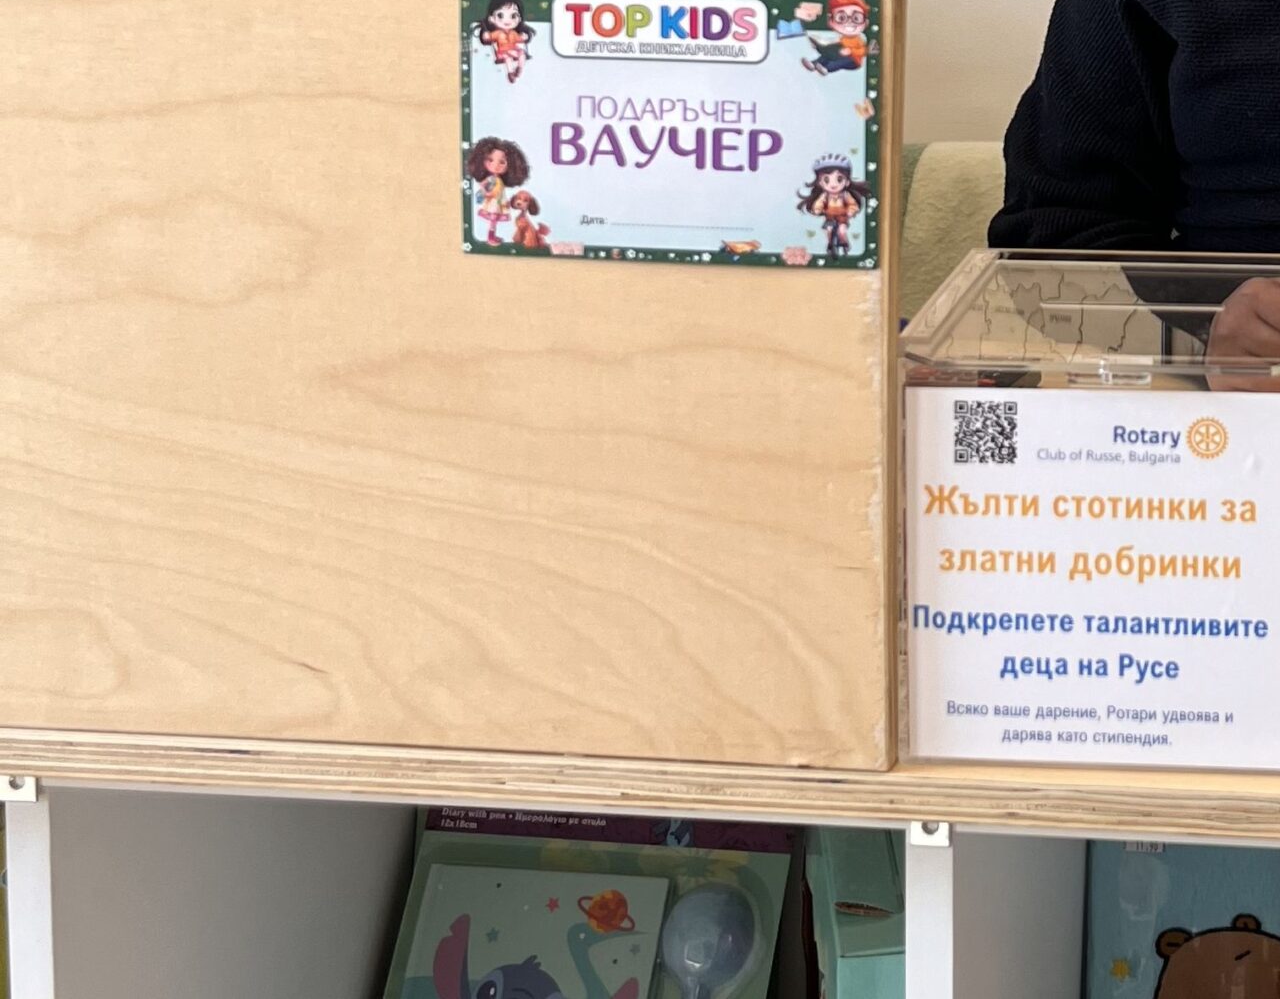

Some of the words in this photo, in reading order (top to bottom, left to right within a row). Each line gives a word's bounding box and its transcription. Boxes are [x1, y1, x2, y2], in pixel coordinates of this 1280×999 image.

[564, 2, 653, 38] TOP
[660, 4, 758, 42] KIDS
[575, 40, 636, 56] ДЕТСКА
[639, 42, 748, 58] КНИЖАРНИЦА
[576, 95, 757, 124] ПОДАРЪЧЕН
[550, 121, 784, 172] ВАУЧЕР
[579, 214, 609, 226] Дата:
[1113, 425, 1182, 448] Rotary
[1037, 448, 1066, 462] Club
[1069, 448, 1083, 462] of
[1086, 449, 1125, 464] Russe,
[1129, 450, 1182, 466] Bulgaria
[924, 484, 1040, 517] Жълти
[1052, 492, 1207, 521] стотинки
[1220, 499, 1257, 523] за
[939, 545, 1056, 574] златни
[1068, 545, 1242, 583] добринки
[912, 604, 1074, 636] Подкрепете
[1084, 612, 1269, 638] талантливите
[1000, 656, 1069, 680] деца
[1078, 657, 1108, 677] на
[1118, 654, 1180, 684] Русе
[946, 701, 989, 717] Всяко
[993, 704, 1031, 718] ваше
[1035, 705, 1101, 722] дарение,
[1106, 705, 1158, 723] Ротари
[1162, 709, 1220, 726] удвоява
[1225, 711, 1234, 722] и
[1001, 729, 1053, 746] дарява
[1056, 729, 1088, 743] като
[1092, 731, 1173, 748] стипендия.
[442, 807, 466, 818] Diary
[468, 809, 487, 819] with
[489, 812, 506, 822] pen
